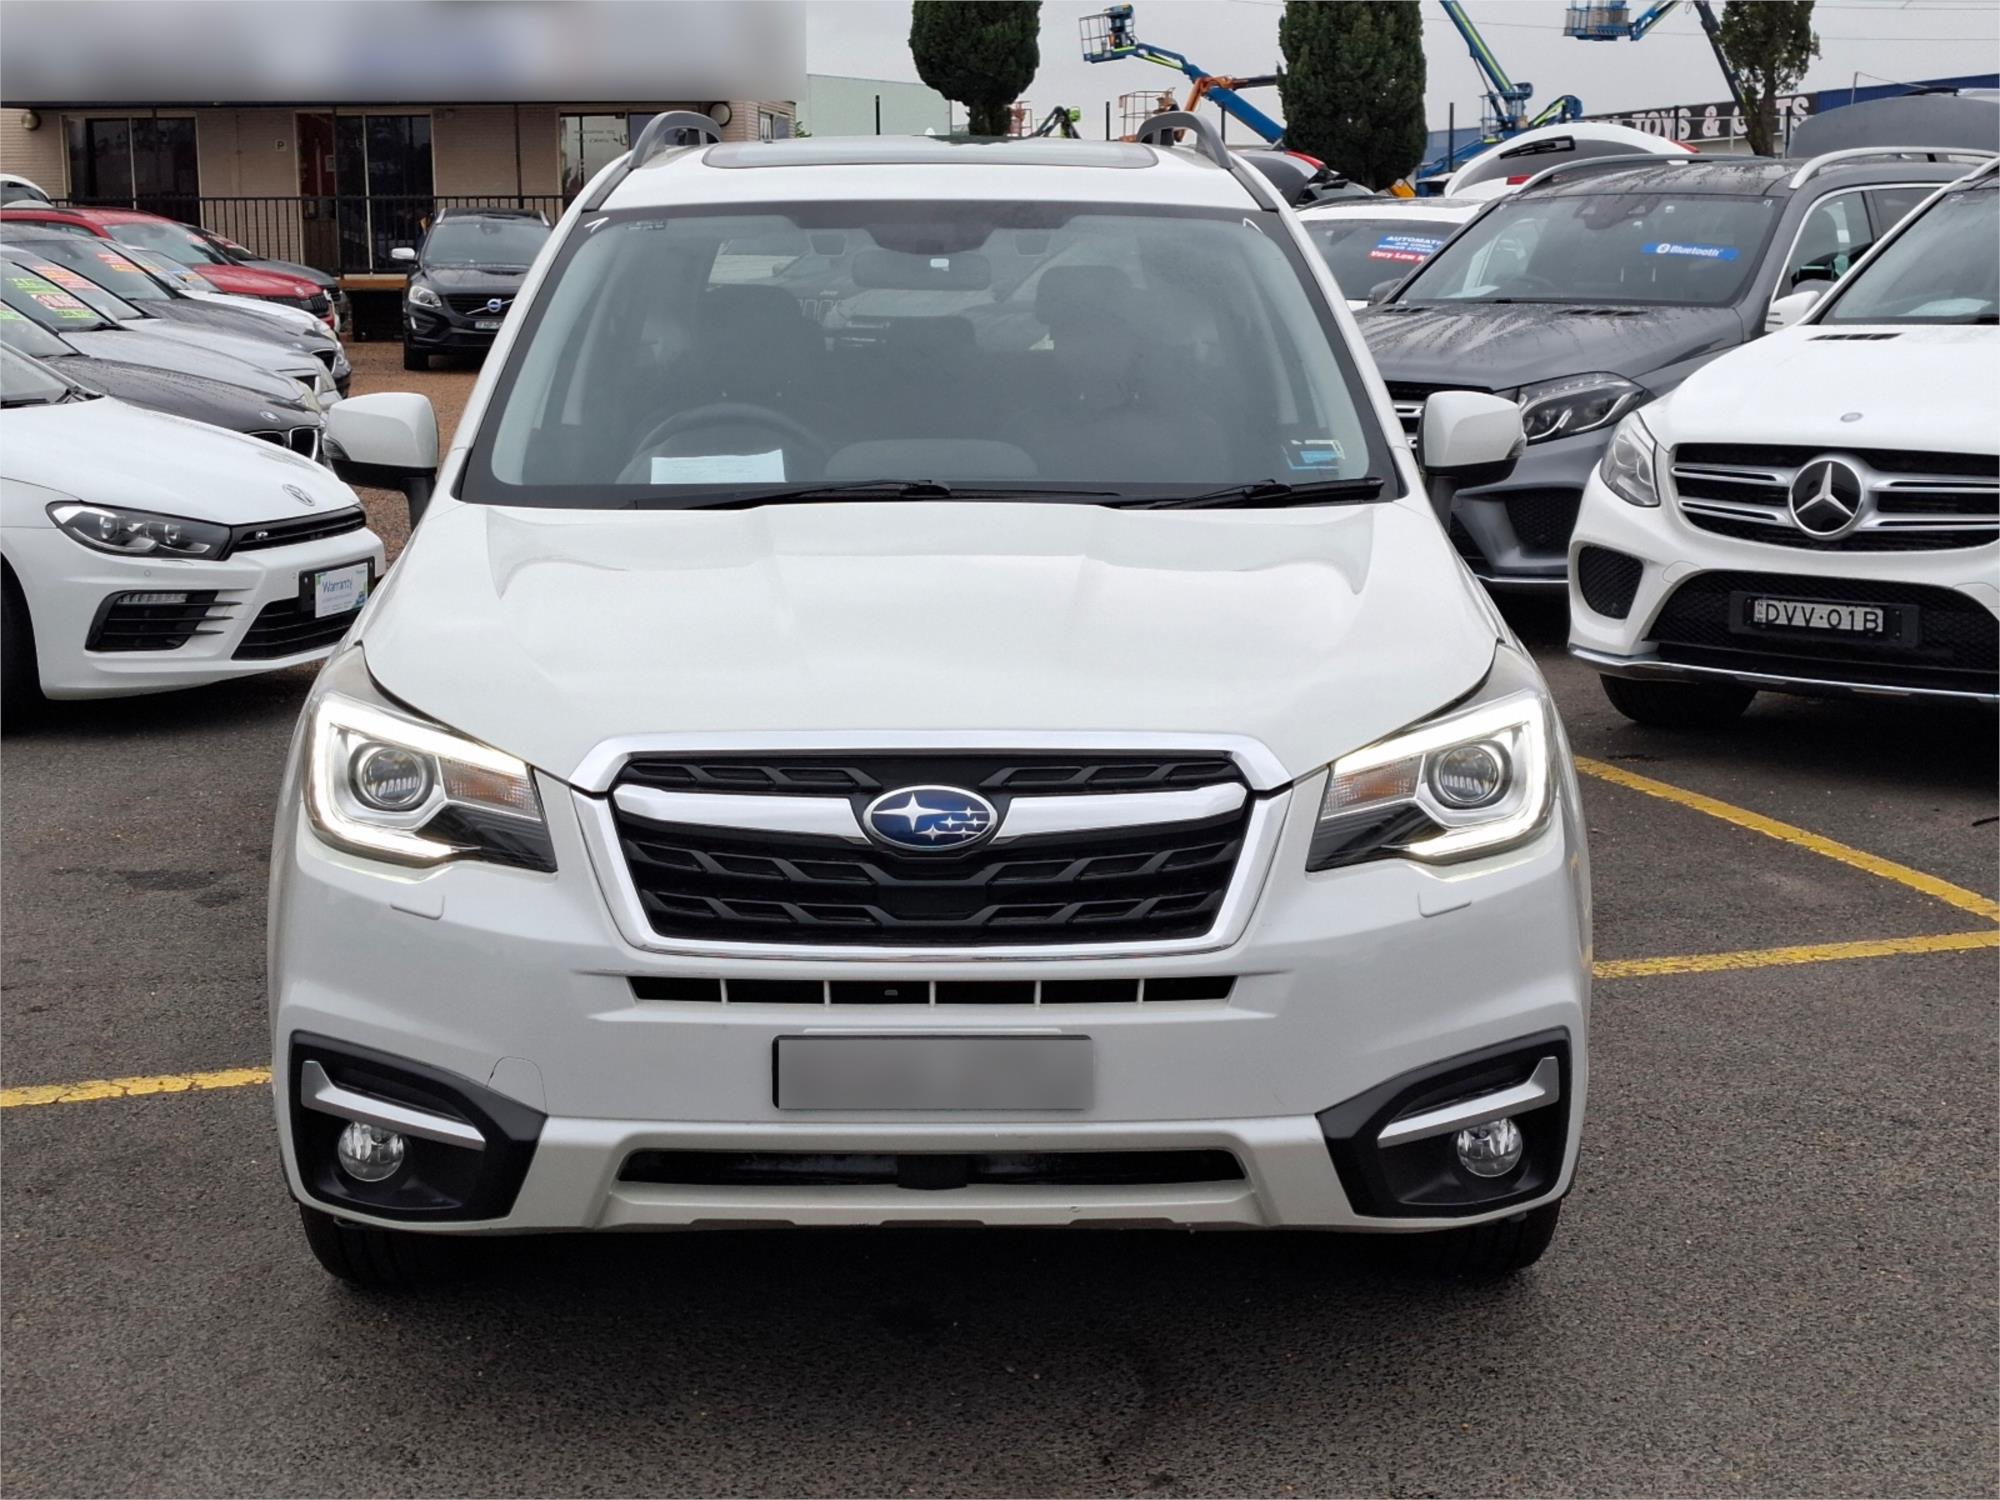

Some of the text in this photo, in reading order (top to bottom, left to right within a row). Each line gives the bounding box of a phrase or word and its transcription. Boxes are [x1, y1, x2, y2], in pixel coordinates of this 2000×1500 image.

[1632, 97, 1809, 140] TOYS & GTS
[1386, 236, 1444, 244] AUTOMATI
[1670, 245, 1720, 256] Bluetooth
